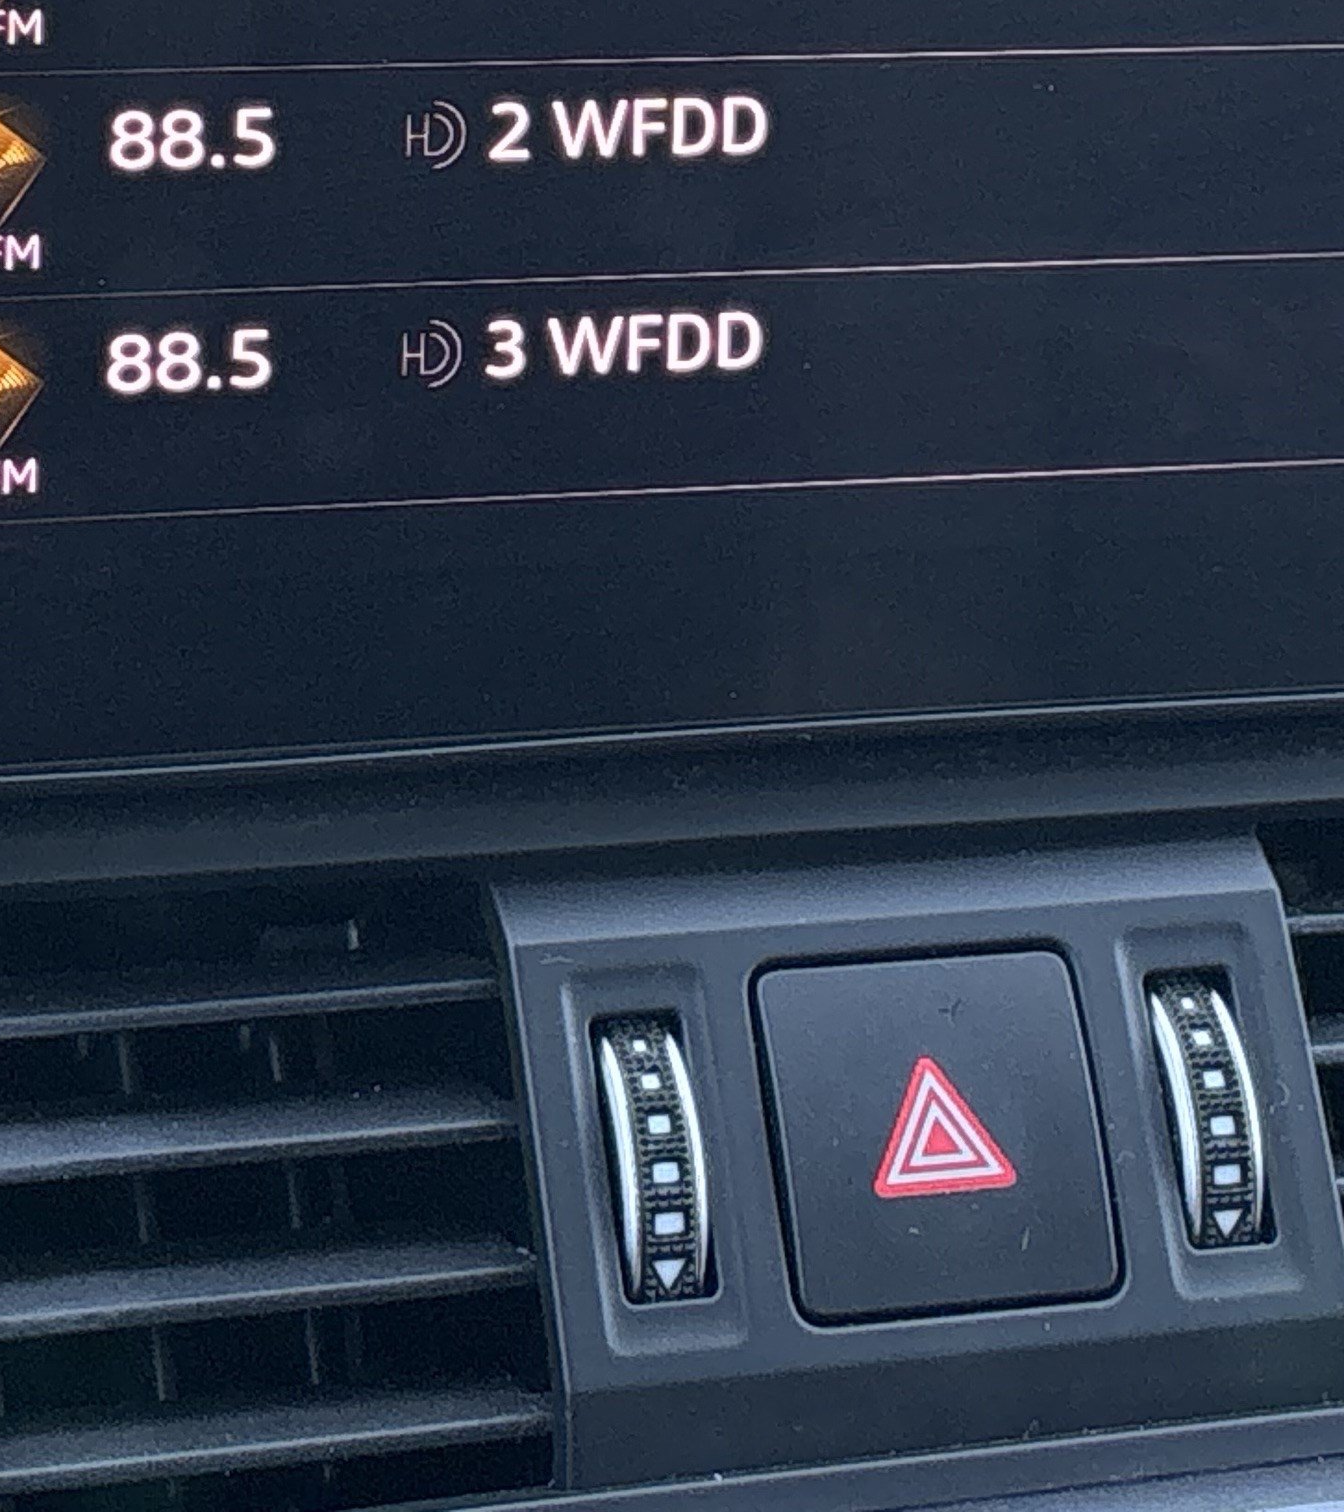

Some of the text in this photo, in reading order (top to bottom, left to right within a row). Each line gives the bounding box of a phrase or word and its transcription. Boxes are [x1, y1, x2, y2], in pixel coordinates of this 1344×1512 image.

[109, 106, 275, 171] 88.5
[488, 101, 531, 162] 2
[551, 95, 768, 159] WFDD
[106, 328, 272, 395] 88.5
[484, 319, 527, 379] 3
[547, 310, 763, 376] WFDD
